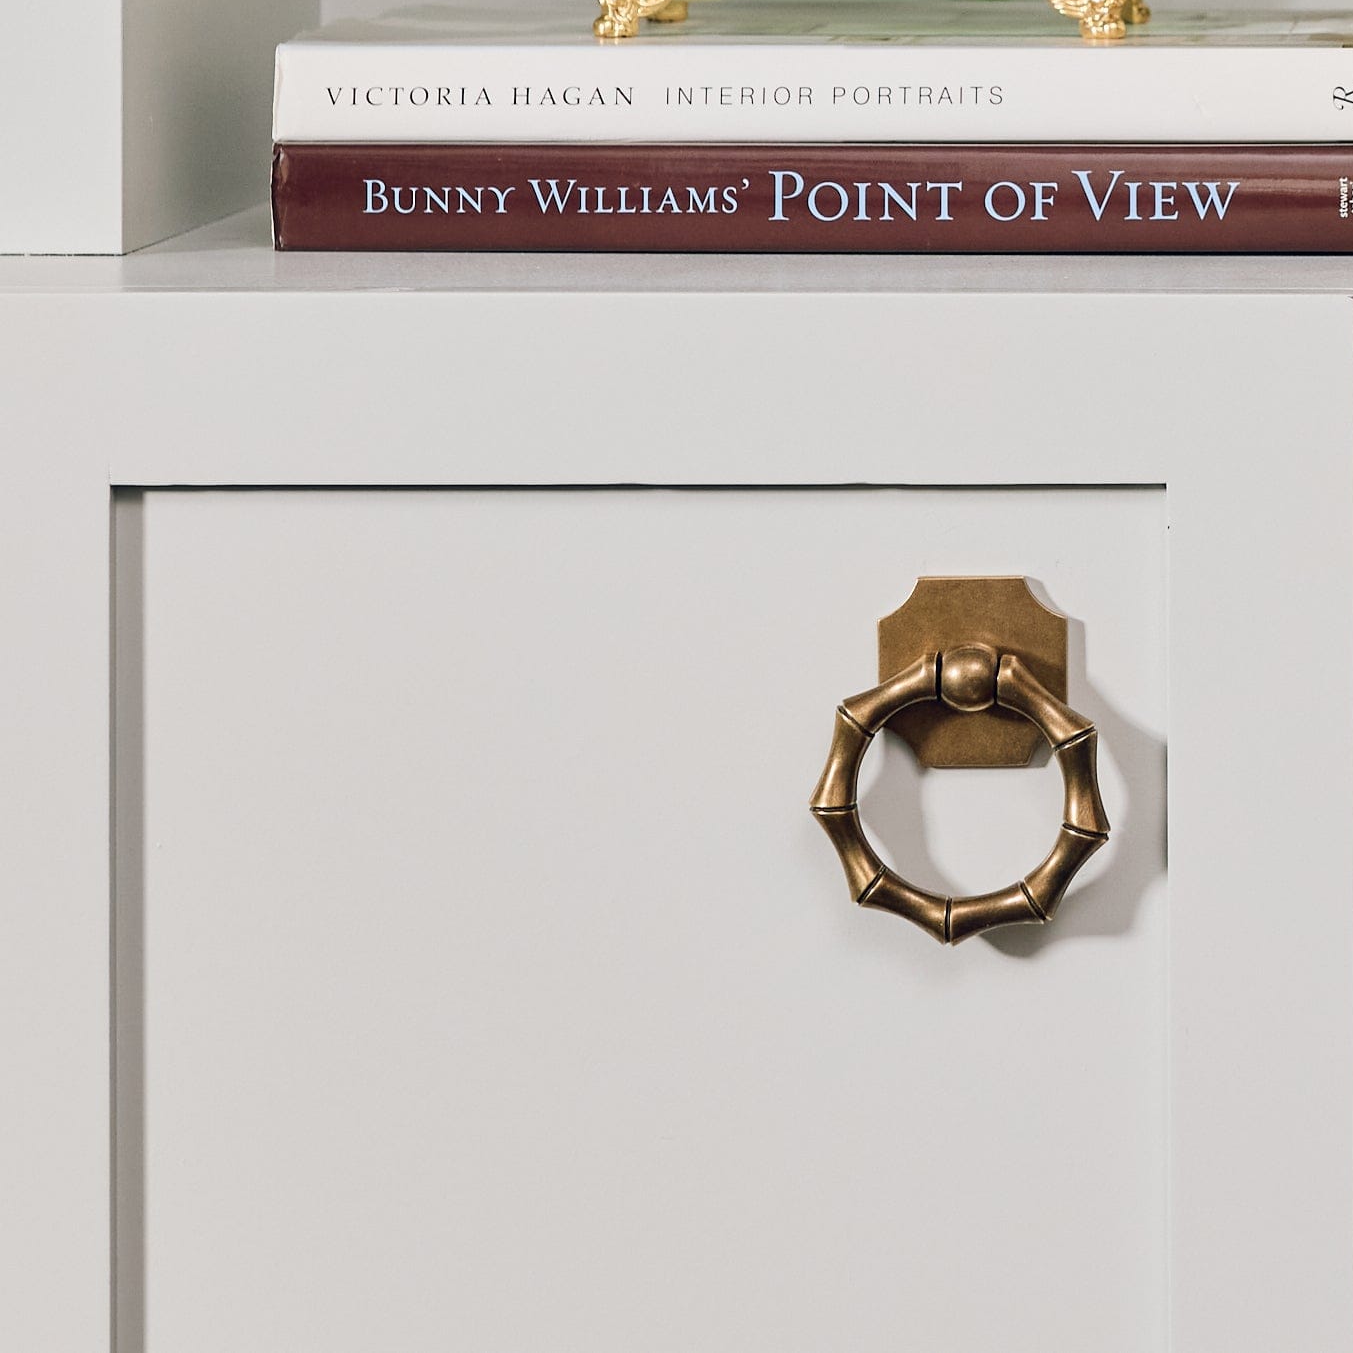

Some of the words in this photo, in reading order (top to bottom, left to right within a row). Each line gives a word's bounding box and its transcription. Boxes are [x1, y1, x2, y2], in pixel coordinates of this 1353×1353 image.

[325, 86, 493, 107] VICTORIA
[511, 85, 636, 107] HAGAN
[665, 86, 814, 106] INTERIOR
[832, 85, 1004, 106] PORTRAITS
[362, 178, 516, 215] BUNNY
[768, 170, 963, 222] POINT
[983, 181, 1059, 222] OF
[1071, 169, 1241, 222] VIEW
[1339, 176, 1349, 218] stewart
